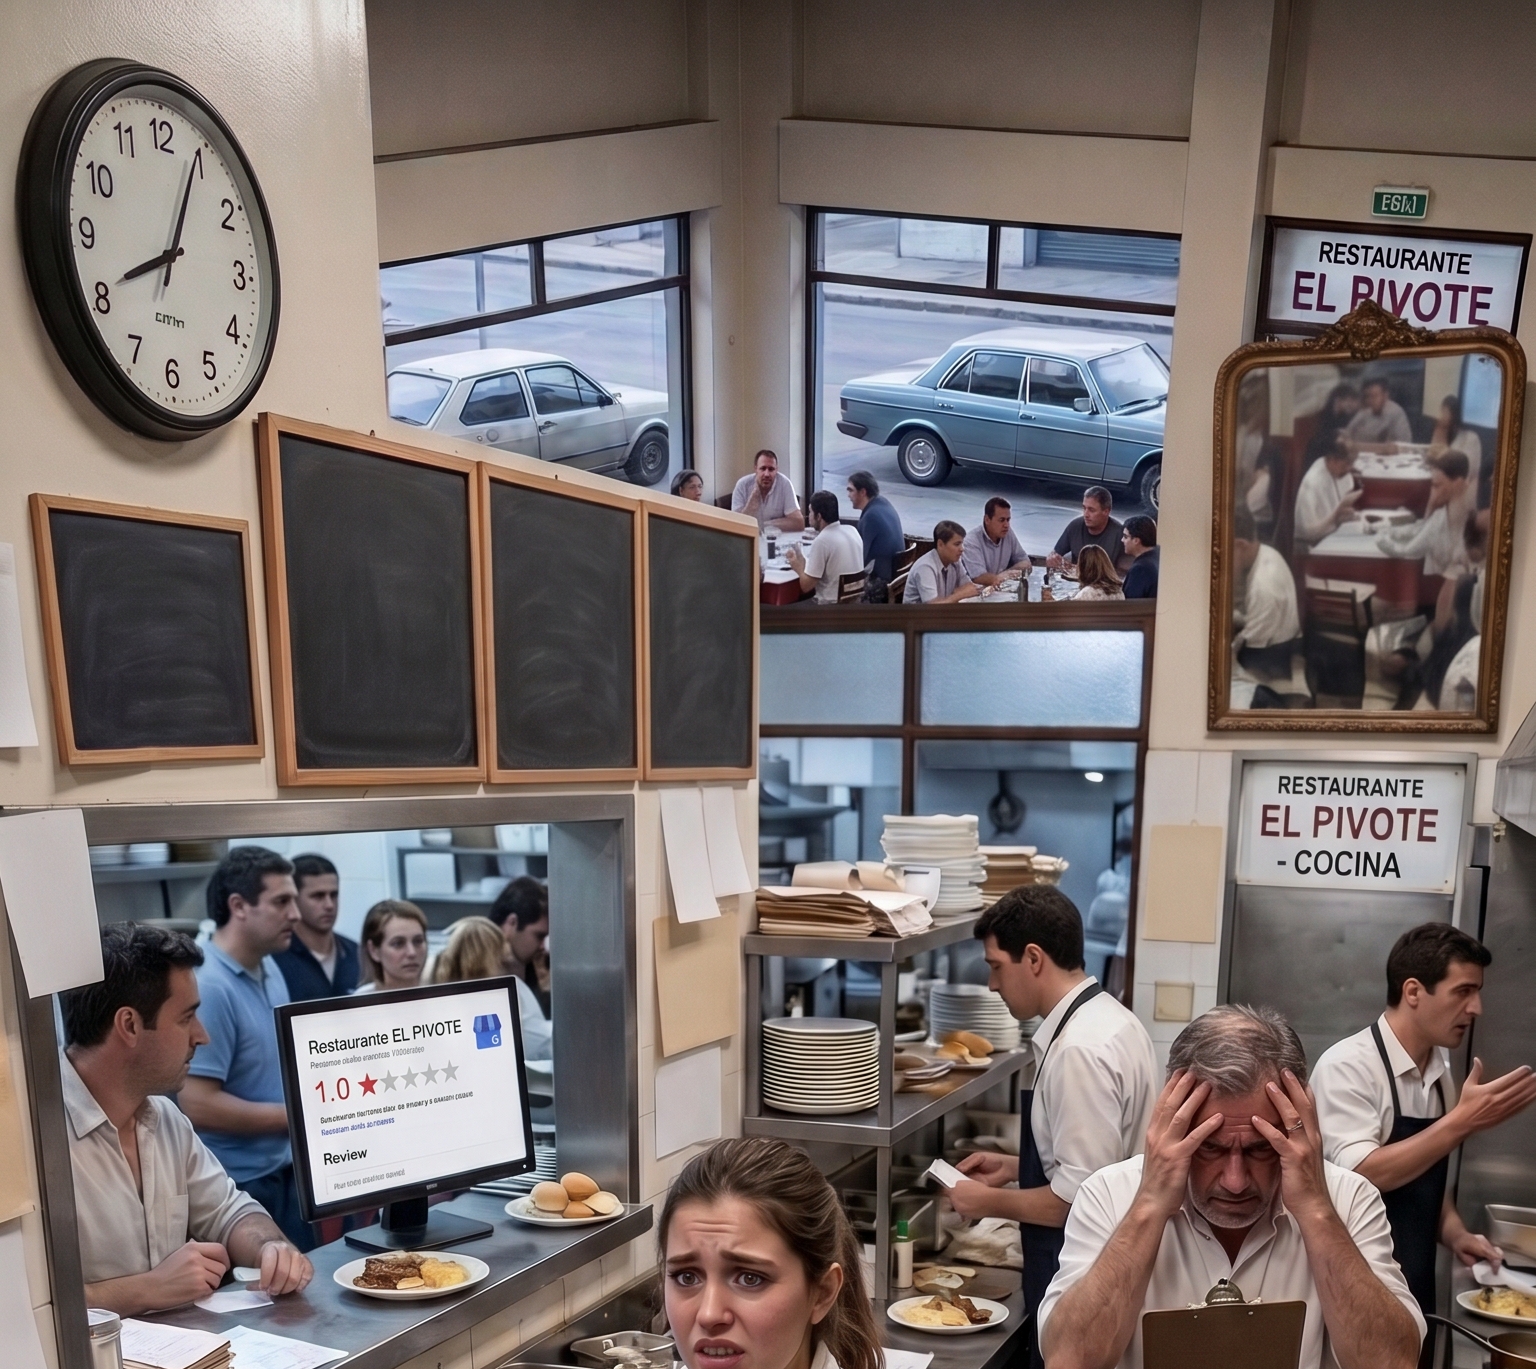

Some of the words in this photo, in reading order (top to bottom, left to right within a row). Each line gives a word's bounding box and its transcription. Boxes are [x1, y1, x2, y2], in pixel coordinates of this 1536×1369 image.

[113, 122, 135, 158] 11
[149, 118, 175, 154] 12
[86, 161, 113, 198] 10
[221, 199, 235, 231] 2
[79, 217, 95, 249] 9
[1318, 241, 1473, 275] RESTAURANTE
[233, 260, 246, 291] 3
[94, 281, 111, 315] 8
[1292, 270, 1337, 313] EL
[1351, 275, 1494, 326] PIVOTE
[226, 314, 240, 345] 4
[127, 334, 142, 365] 7
[165, 358, 180, 389] 6
[202, 351, 216, 380] 5
[1278, 776, 1424, 798] RESTAURANTE
[1260, 804, 1300, 838] EL
[1312, 805, 1439, 843] PIVOTE
[1294, 849, 1401, 879] COCINA
[308, 1032, 389, 1055] Restaurante
[392, 1028, 410, 1043] EL
[413, 1019, 462, 1040] PIVOTE
[491, 1034, 500, 1045] G
[315, 1077, 350, 1103] 1.0
[323, 1149, 368, 1166] Review
